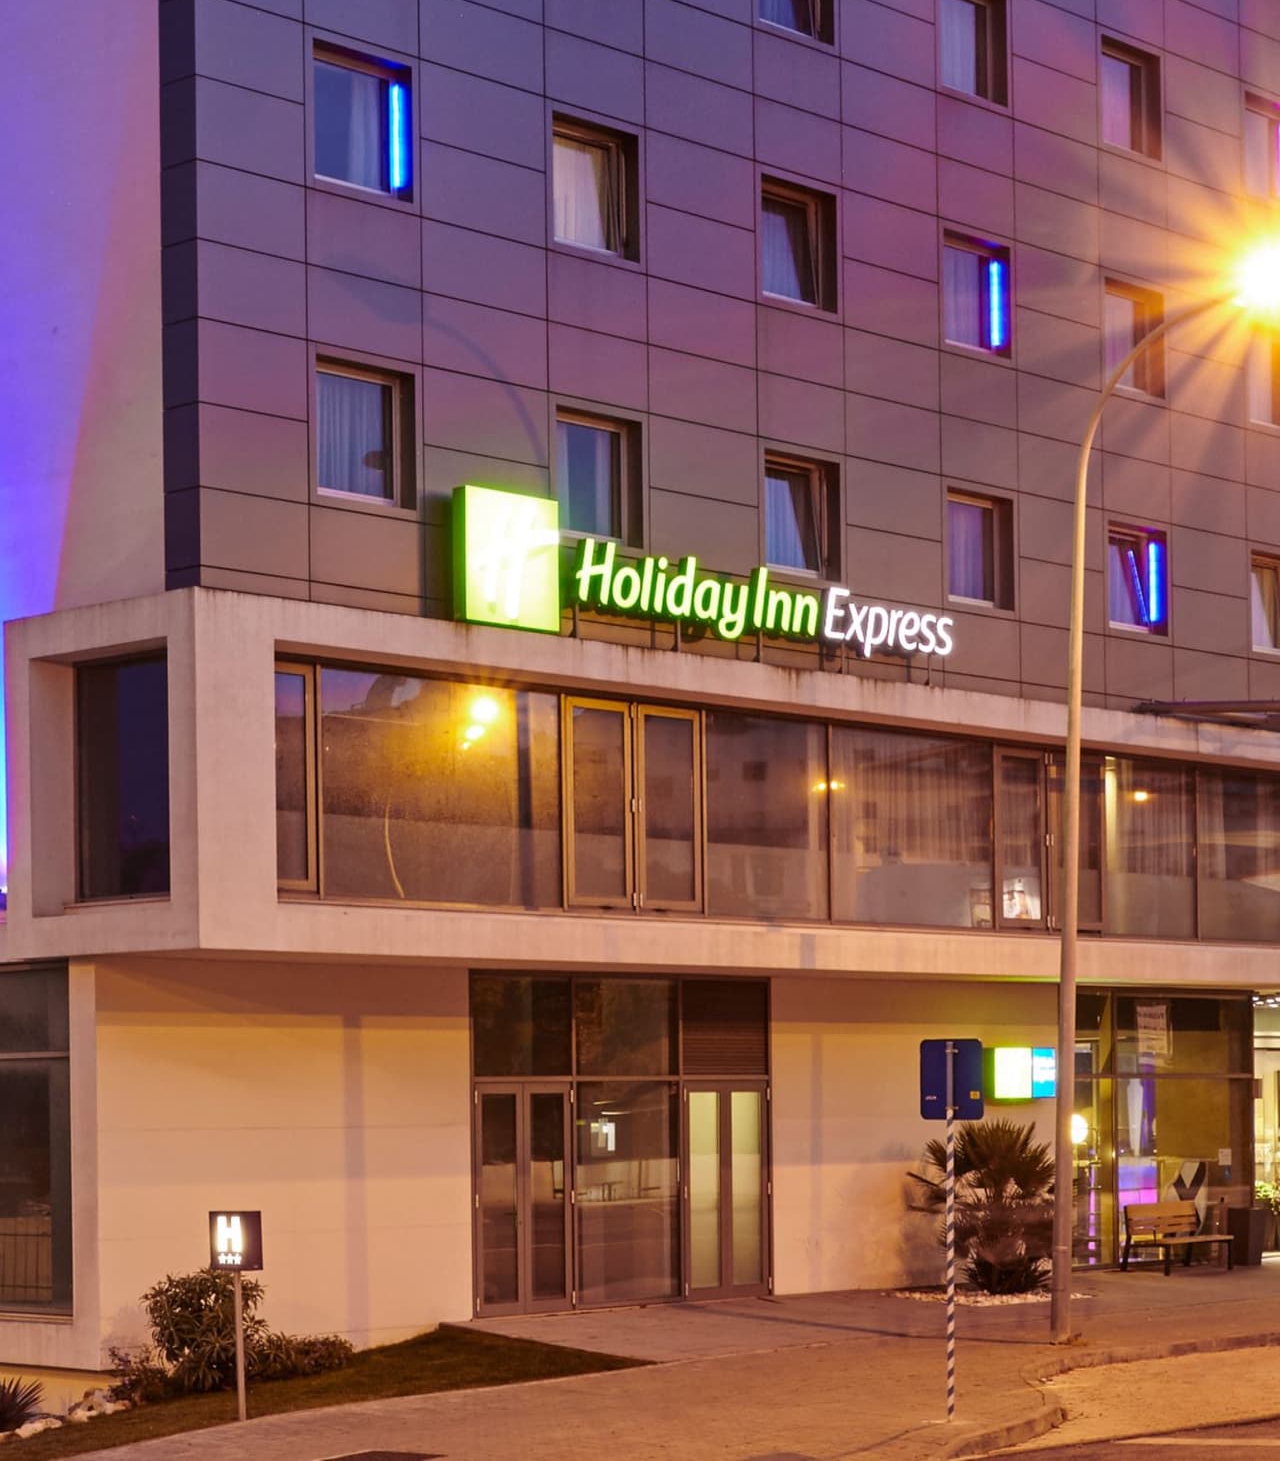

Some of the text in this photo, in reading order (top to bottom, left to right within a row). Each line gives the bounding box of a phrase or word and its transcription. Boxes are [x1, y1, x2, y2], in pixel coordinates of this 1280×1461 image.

[575, 537, 954, 659] Holiday Inn Express
[217, 1215, 241, 1253] H
